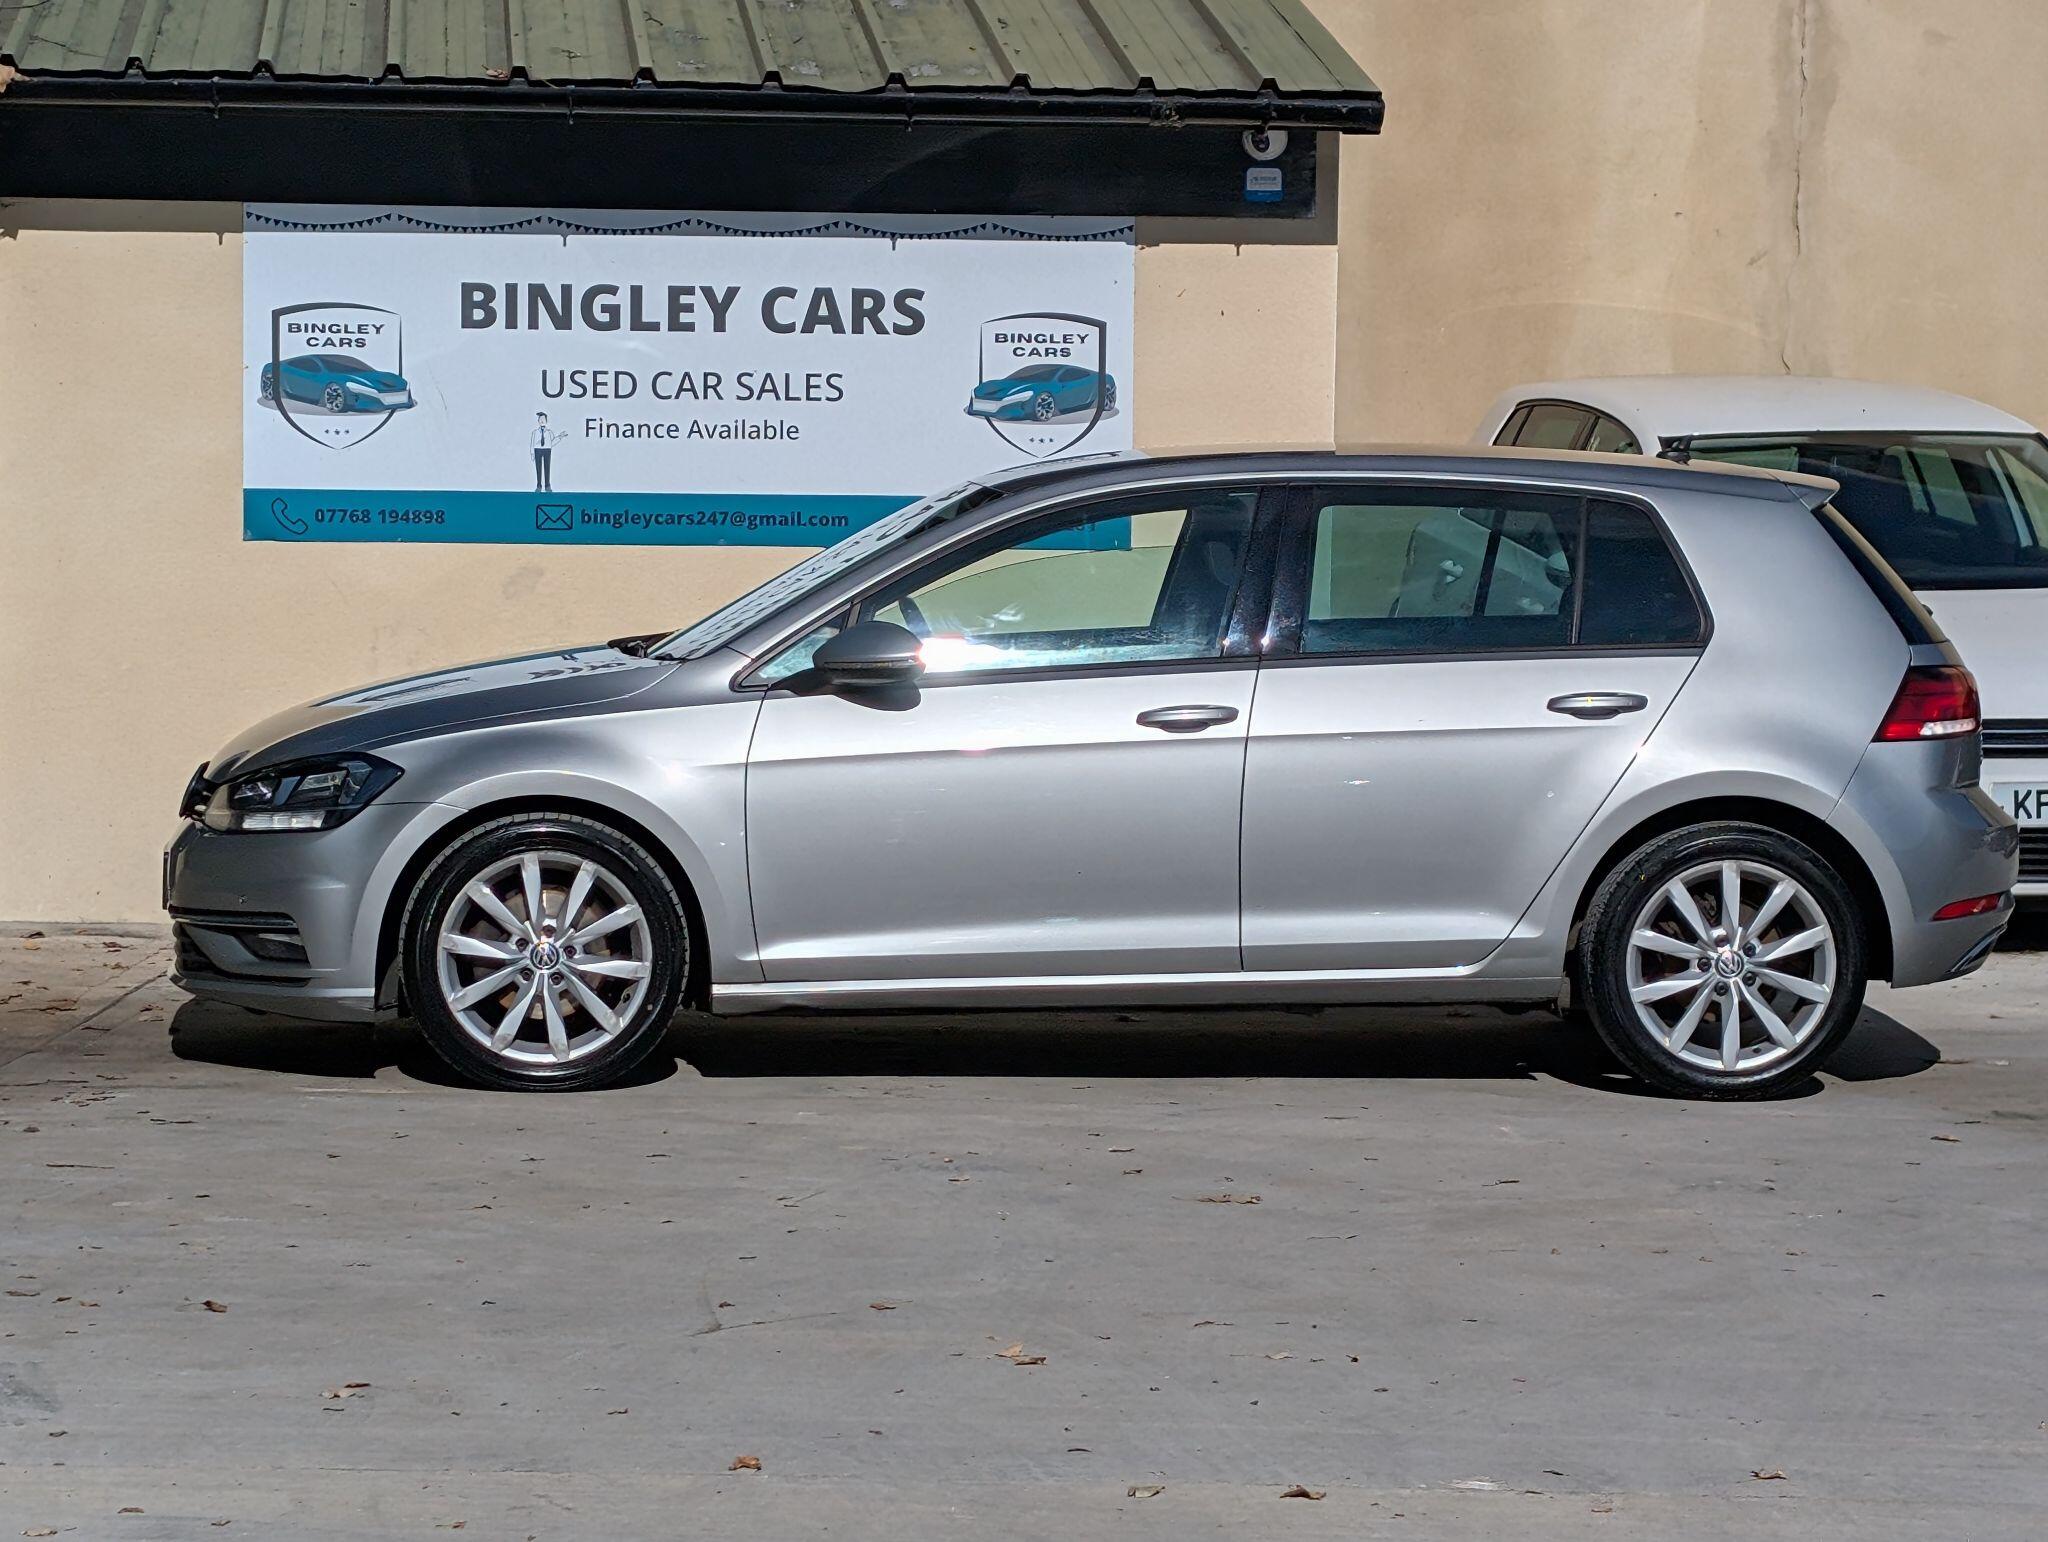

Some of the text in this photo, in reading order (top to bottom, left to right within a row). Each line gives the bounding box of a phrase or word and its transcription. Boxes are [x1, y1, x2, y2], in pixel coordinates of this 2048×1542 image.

[460, 281, 926, 336] BINGLEY CARS
[287, 322, 385, 335] BINGLEY
[305, 336, 367, 348] CARS
[994, 332, 1090, 345] BINGLEY
[1012, 346, 1072, 358] CARS
[541, 369, 844, 402] USED CAR SALES
[585, 417, 800, 441] Finance Available
[314, 508, 446, 525] 07768 194898
[580, 508, 850, 531] bingleycars247@gmail.com
